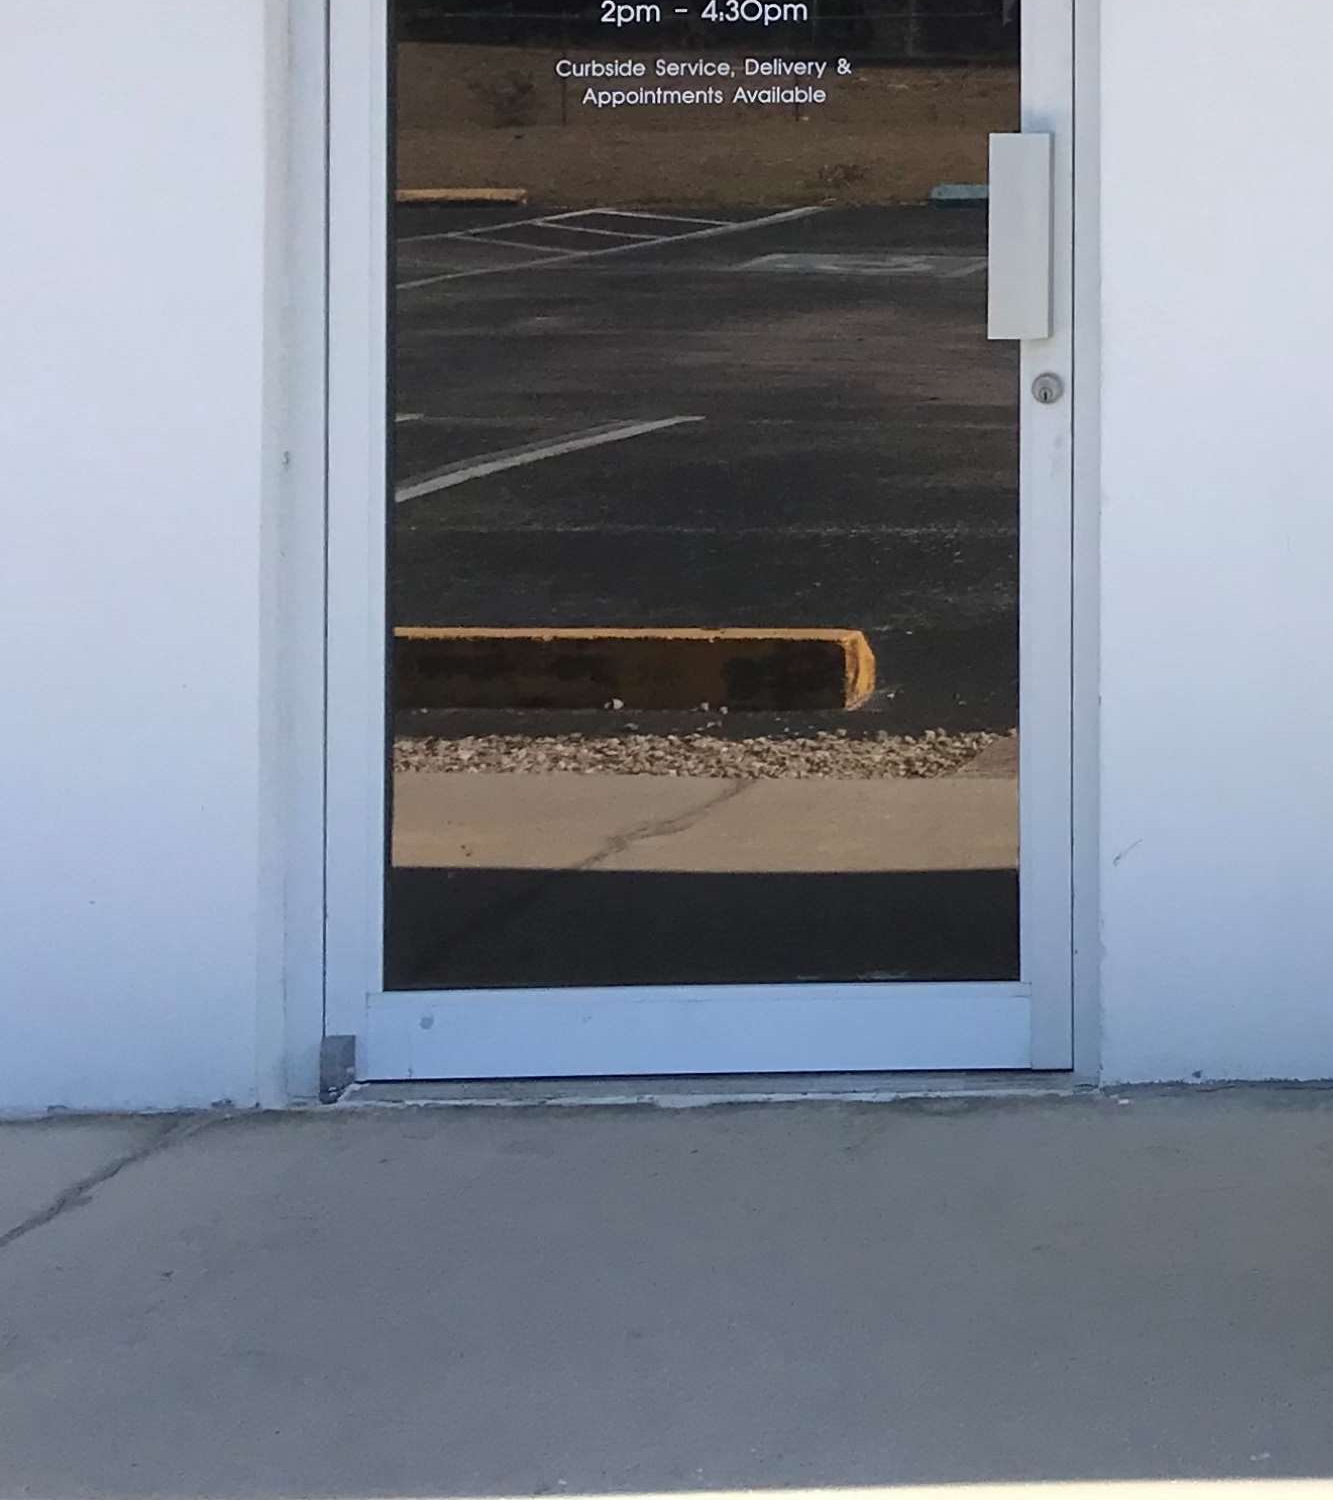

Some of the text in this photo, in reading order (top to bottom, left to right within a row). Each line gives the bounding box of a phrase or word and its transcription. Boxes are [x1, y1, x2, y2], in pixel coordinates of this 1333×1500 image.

[600, 0, 661, 27] 2pm
[555, 58, 852, 79] Curbside Service, Delivery &
[582, 86, 827, 108] Appointments Available
